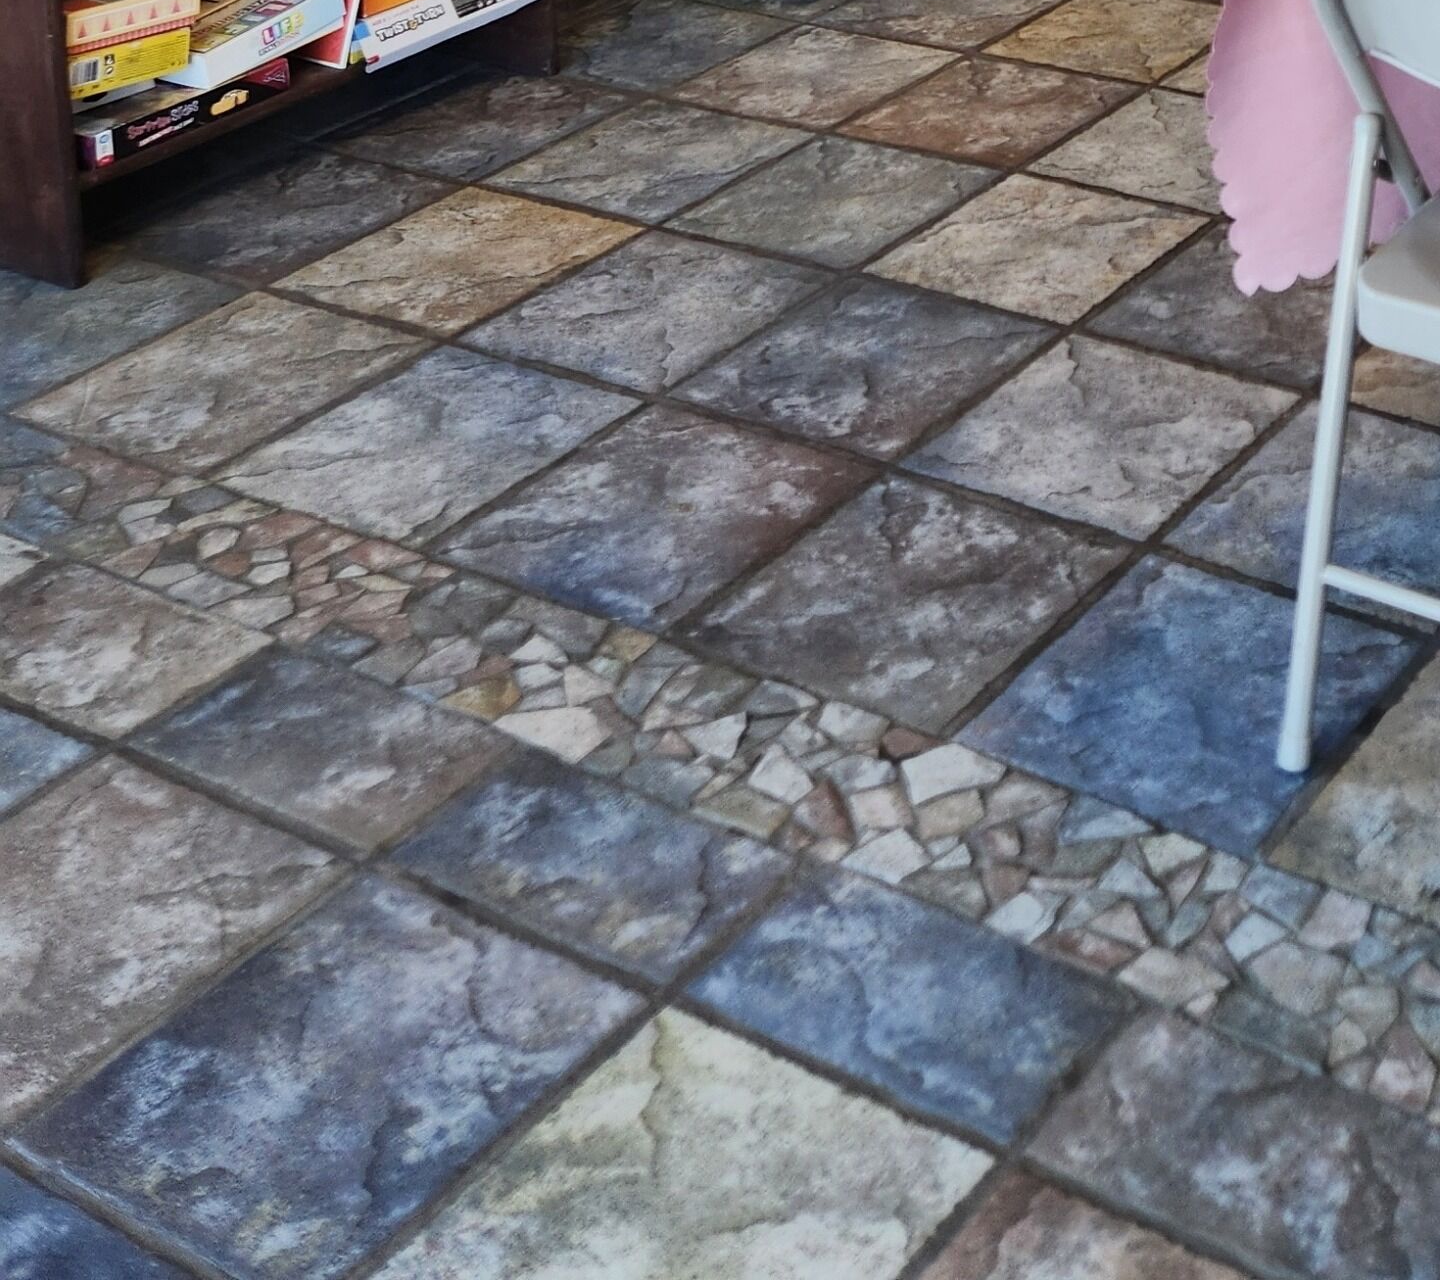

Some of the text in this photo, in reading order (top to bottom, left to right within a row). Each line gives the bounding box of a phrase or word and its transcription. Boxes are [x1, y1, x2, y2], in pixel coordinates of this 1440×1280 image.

[261, 11, 305, 46] LIFE
[375, 20, 410, 42] TWIST
[416, 3, 446, 26] TURN
